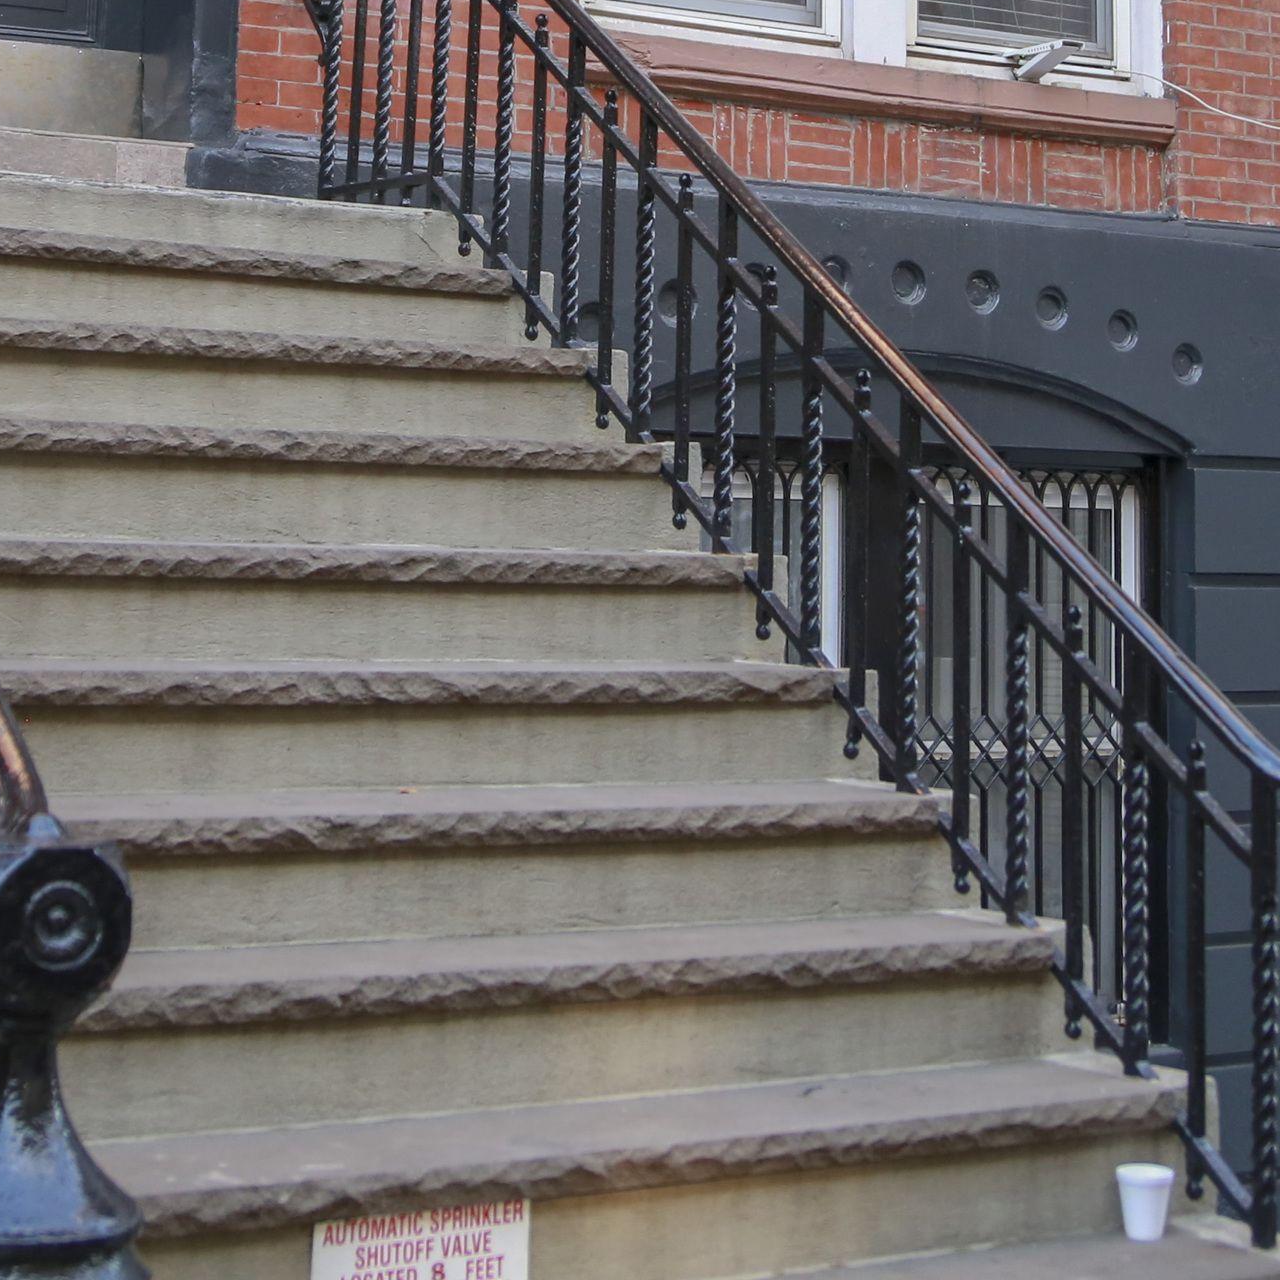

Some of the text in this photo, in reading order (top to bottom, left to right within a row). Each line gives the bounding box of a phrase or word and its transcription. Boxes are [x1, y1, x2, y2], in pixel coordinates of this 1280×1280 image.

[323, 1199, 523, 1247] AUTOMATIC SPRINKLER
[354, 1230, 492, 1270] SHUTOFF VALVE
[431, 1262, 447, 1280] 8
[465, 1255, 504, 1280] FEET
